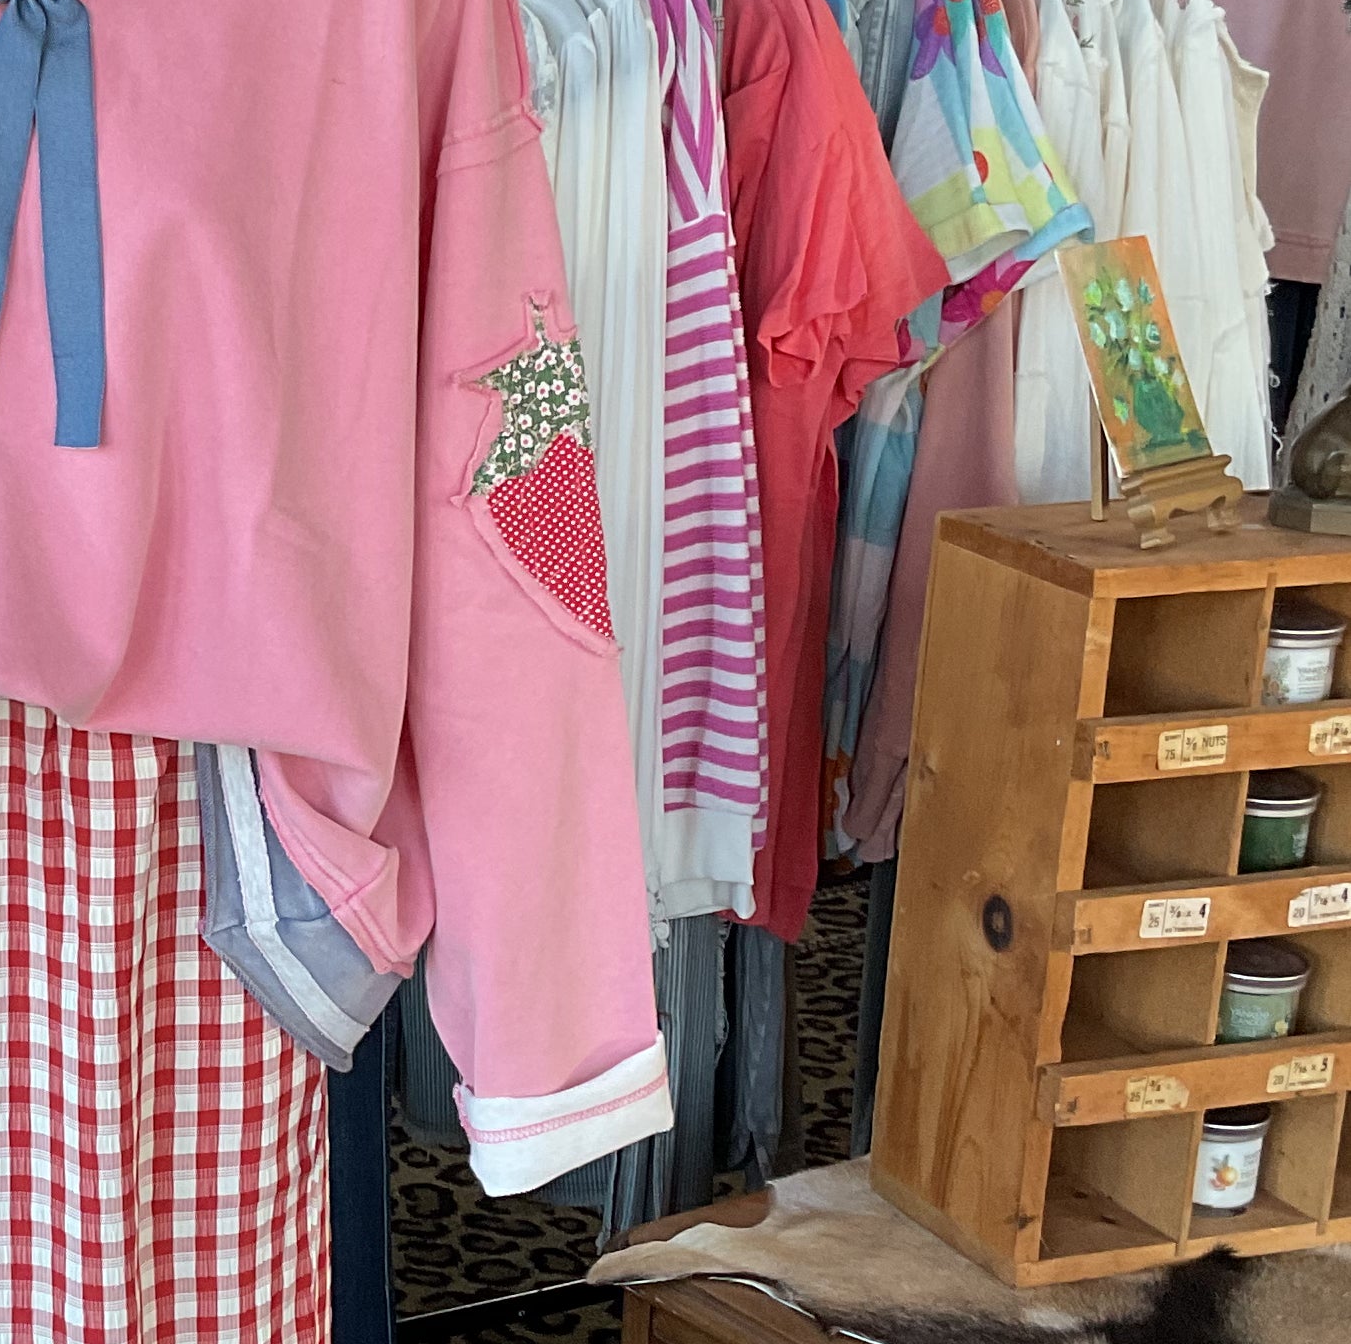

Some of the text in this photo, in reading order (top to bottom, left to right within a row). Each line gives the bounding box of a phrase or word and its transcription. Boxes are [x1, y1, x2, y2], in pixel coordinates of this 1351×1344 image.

[1201, 735, 1227, 749] NUTS
[1164, 749, 1176, 761] 75
[1341, 887, 1348, 903] 4
[1199, 903, 1207, 918] 4
[1293, 907, 1305, 918] 20
[1320, 1057, 1329, 1072] 5
[1130, 1091, 1141, 1103] 25
